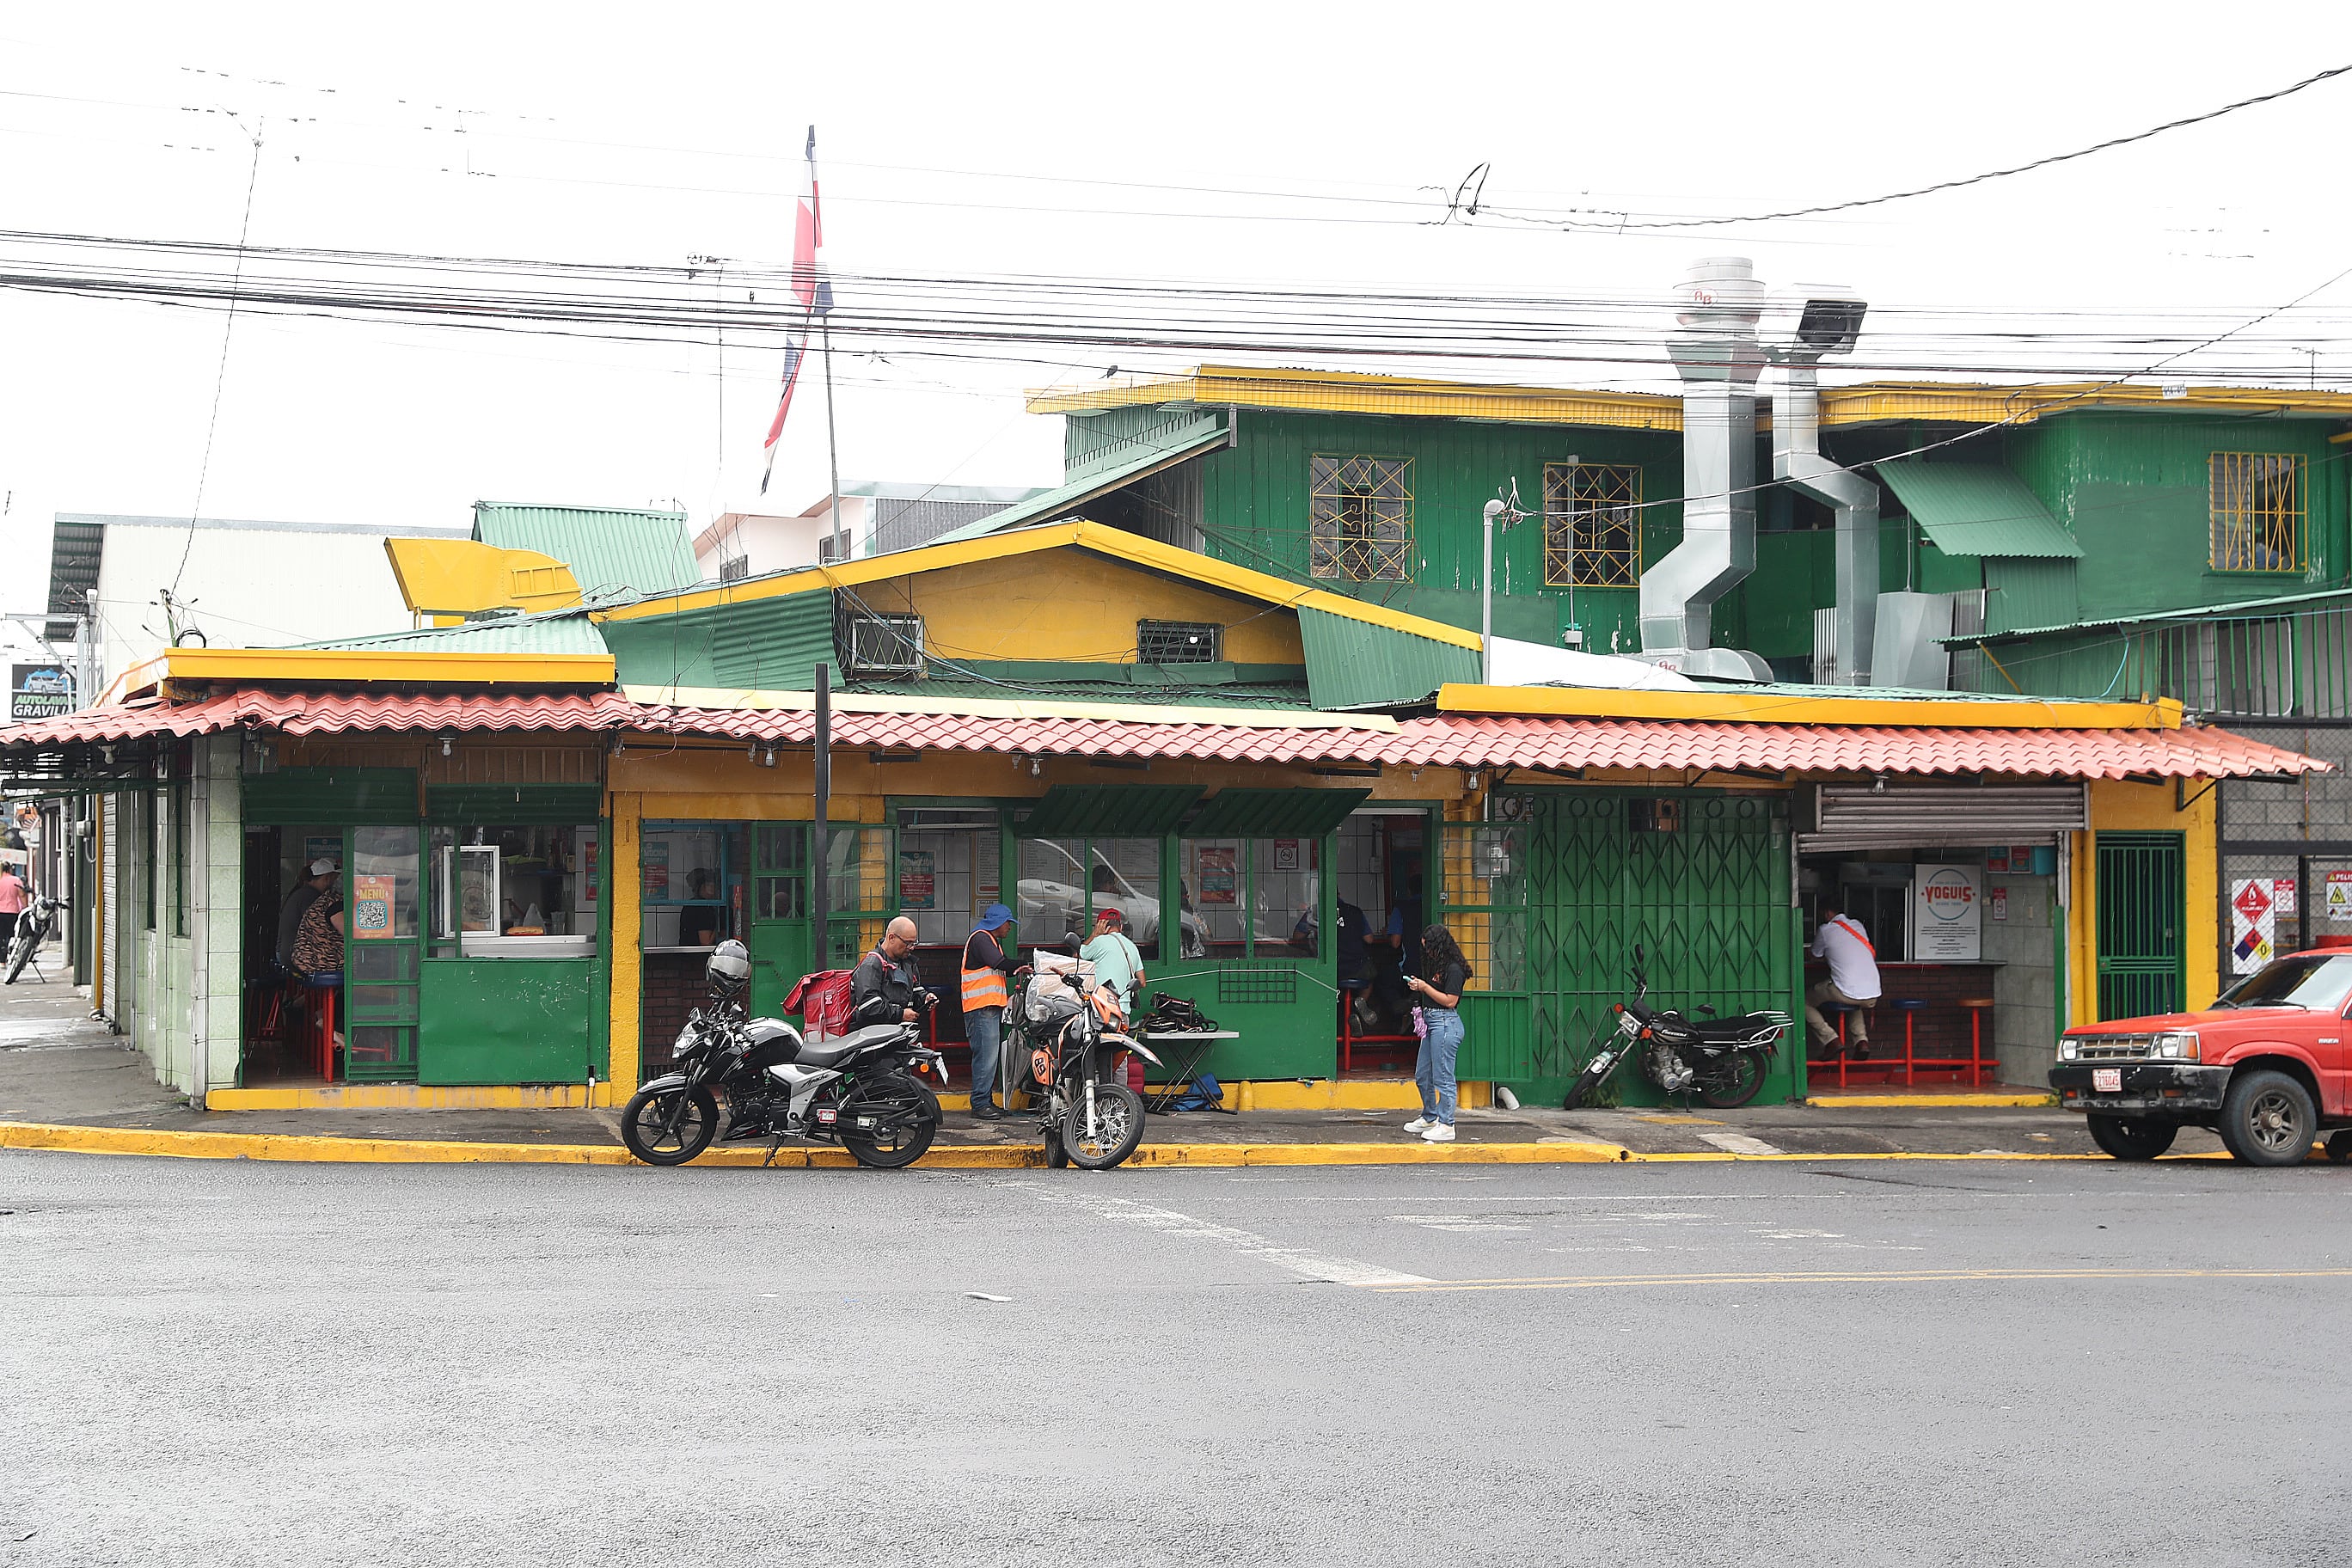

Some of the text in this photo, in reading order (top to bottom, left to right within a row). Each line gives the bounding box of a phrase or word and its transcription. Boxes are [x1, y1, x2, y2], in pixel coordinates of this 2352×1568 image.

[13, 705, 69, 716] GRAVILI
[359, 886, 386, 900] MENÚ
[1925, 885, 1973, 903] YOGUIS
[2260, 944, 2267, 955] 0
